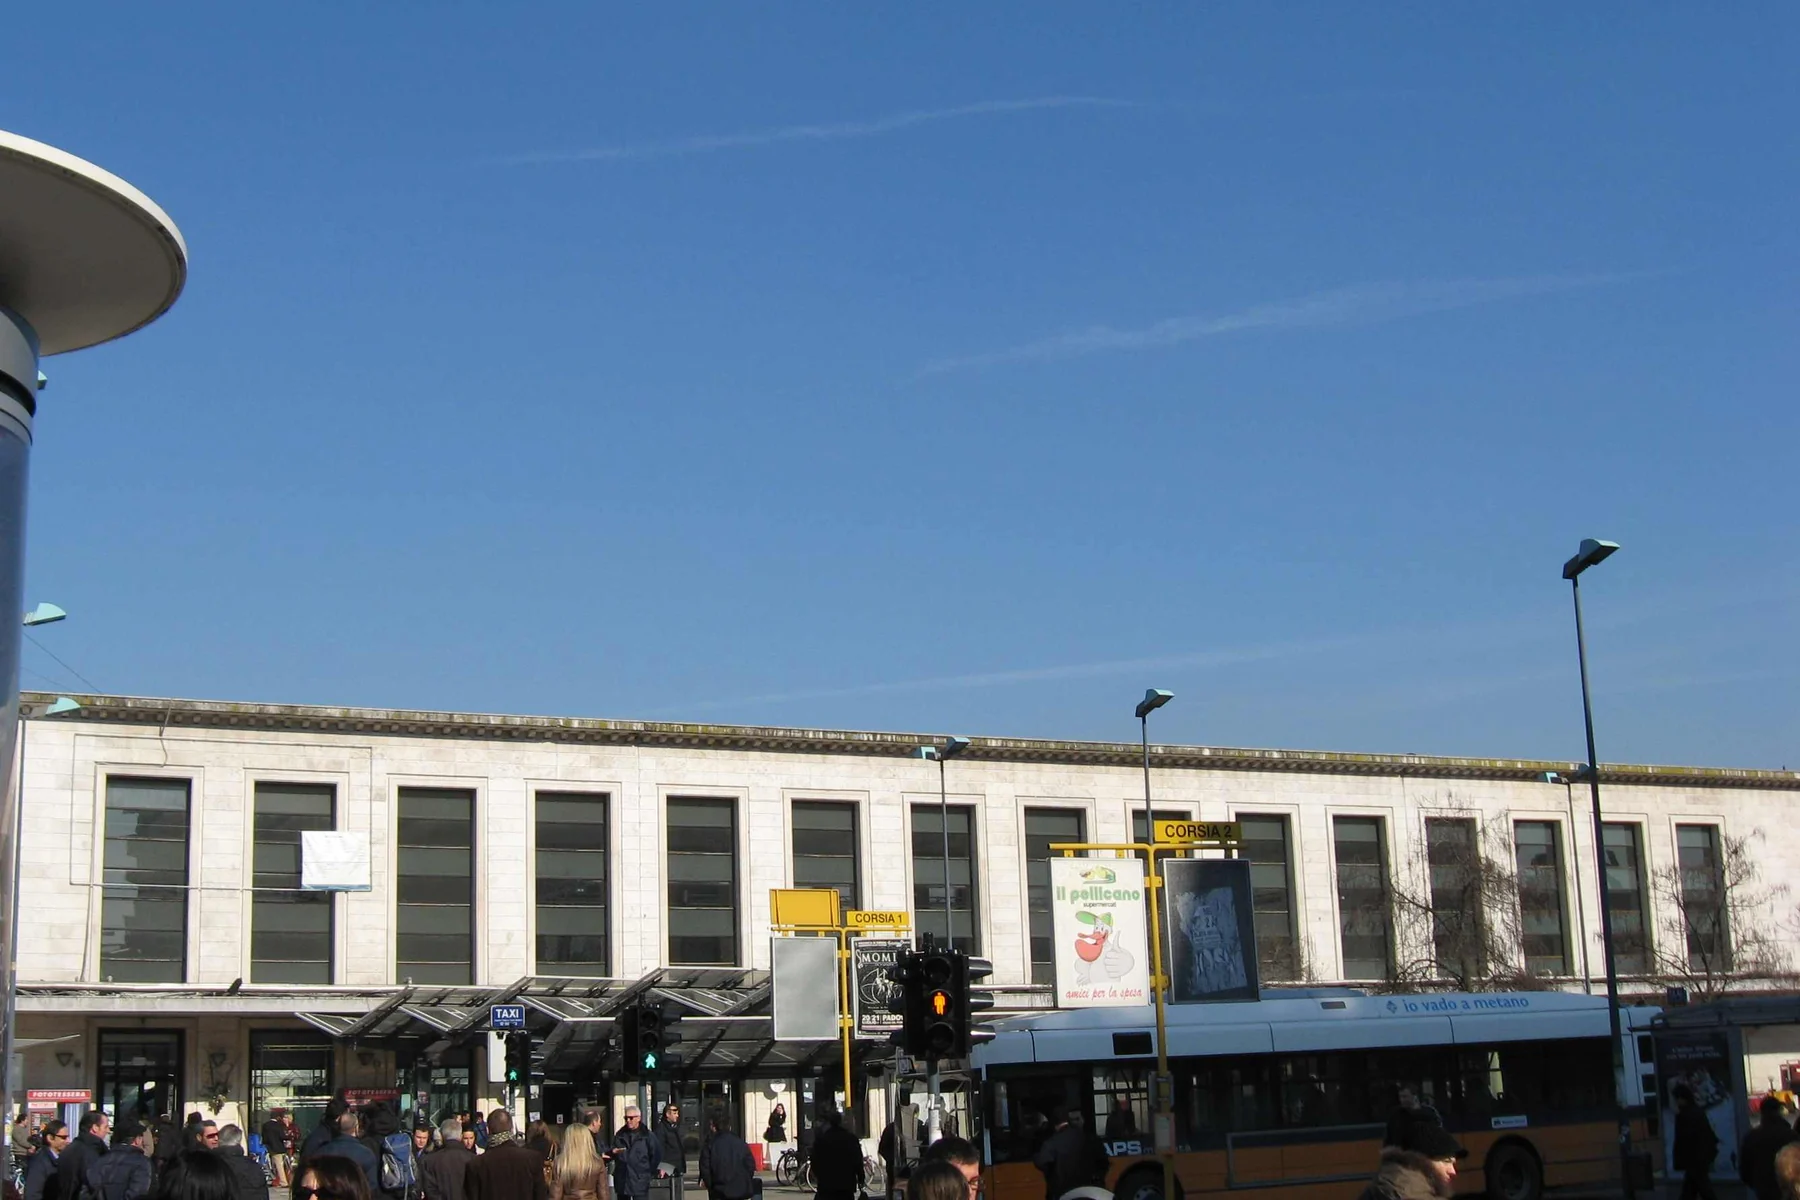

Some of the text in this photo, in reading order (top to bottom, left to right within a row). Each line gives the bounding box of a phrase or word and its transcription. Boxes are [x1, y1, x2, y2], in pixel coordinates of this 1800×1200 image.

[1165, 824, 1232, 838] CORSIA 2
[1070, 886, 1140, 904] pellicano
[855, 913, 903, 923] CORSIA 1
[861, 952, 897, 963] MOMI
[1065, 987, 1142, 1000] amici per la spesa
[1402, 996, 1530, 1013] io vado a metano
[495, 1008, 519, 1018] TAXI
